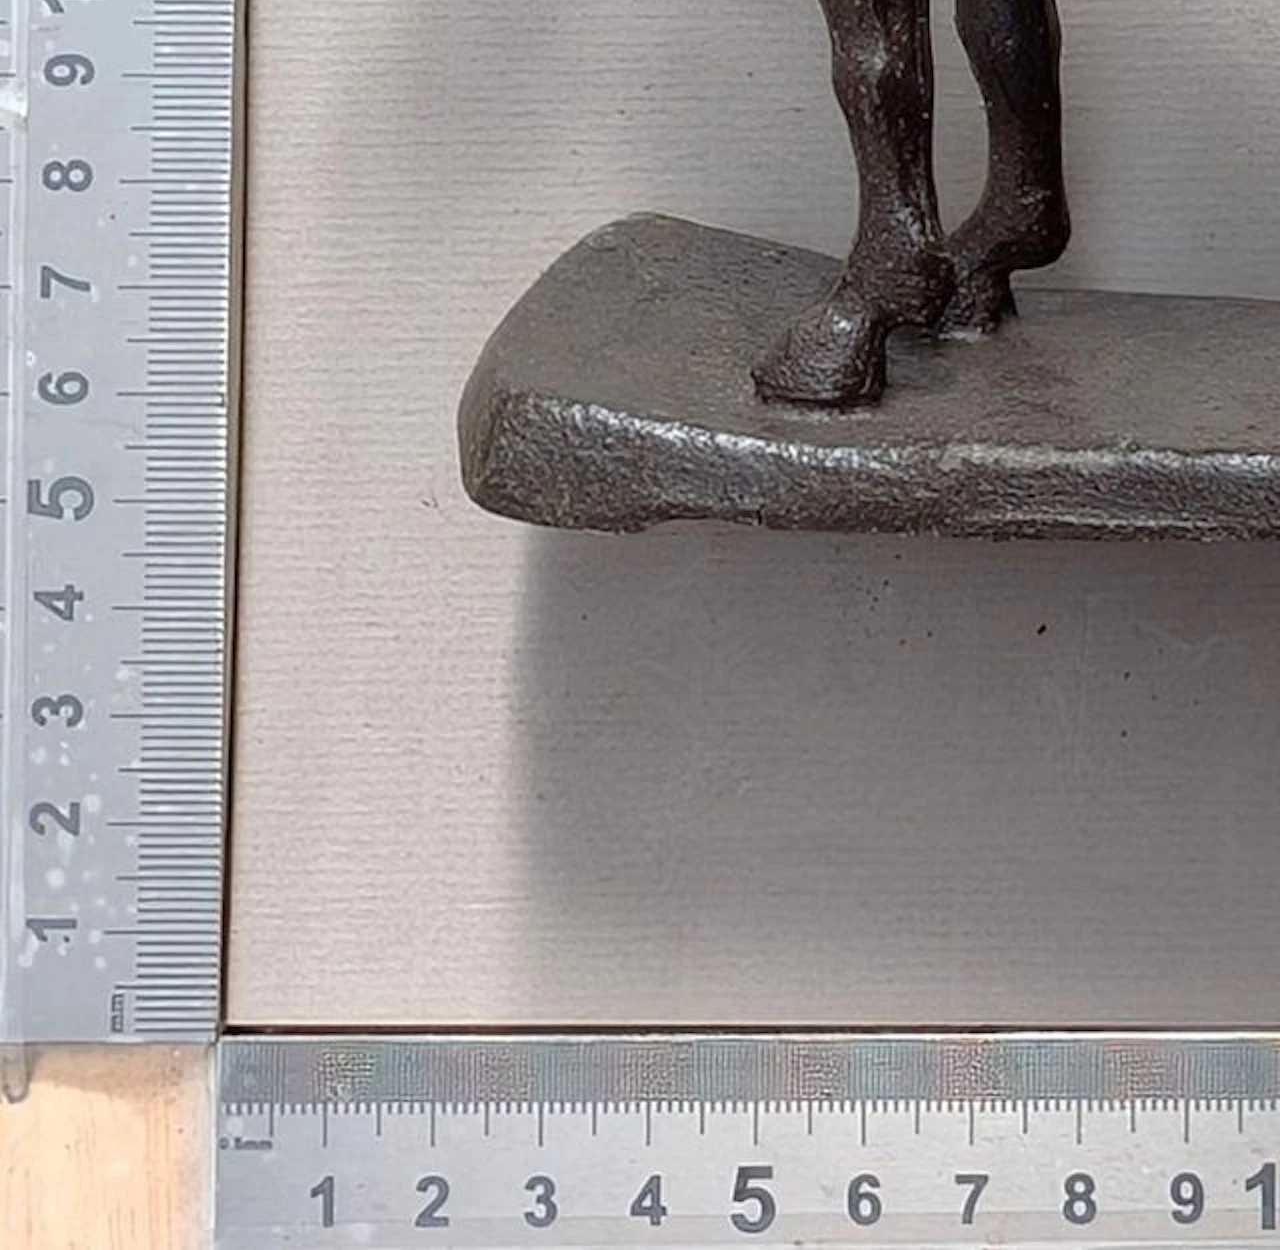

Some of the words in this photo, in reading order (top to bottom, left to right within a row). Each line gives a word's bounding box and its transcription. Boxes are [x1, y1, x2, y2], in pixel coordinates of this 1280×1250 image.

[43, 54, 95, 86] 9
[42, 160, 93, 192] 8
[40, 265, 91, 299] 7
[38, 372, 89, 405] 6
[26, 476, 94, 521] 5
[33, 584, 84, 622] 4
[31, 694, 83, 728] 3
[28, 802, 80, 837] 2
[26, 918, 77, 942] 1
[310, 1176, 335, 1228] 1
[415, 1176, 450, 1228] 2
[524, 1175, 558, 1227] 3
[630, 1175, 668, 1227] 4
[730, 1166, 776, 1234] 5
[848, 1174, 882, 1226] 6
[954, 1174, 990, 1226] 7
[1063, 1174, 1097, 1226] 8
[1170, 1173, 1204, 1226] 9
